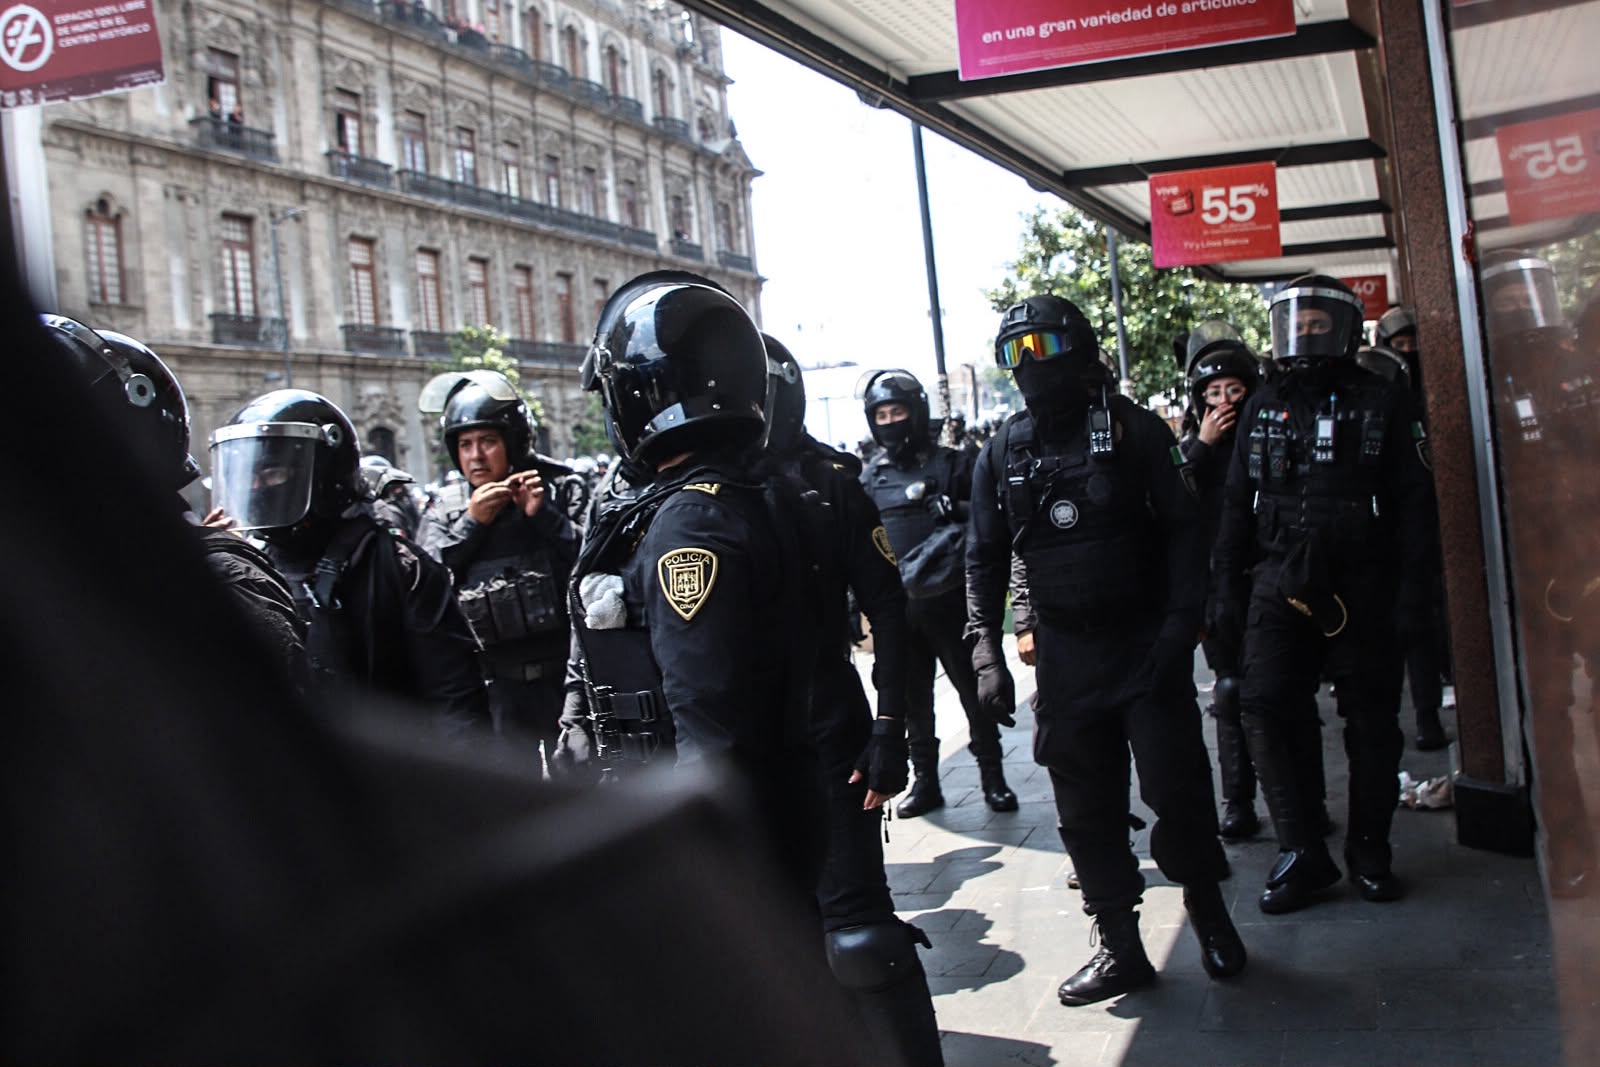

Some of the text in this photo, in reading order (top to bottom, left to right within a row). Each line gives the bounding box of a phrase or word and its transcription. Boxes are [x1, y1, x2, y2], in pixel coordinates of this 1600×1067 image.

[54, 9, 94, 25] ESPACIO
[56, 25, 71, 37] DE
[115, 15, 128, 26] EL
[982, 30, 1003, 43] en
[1006, 25, 1035, 40] una
[1039, 18, 1077, 38] gran
[1080, 4, 1152, 28] variedad
[1156, 3, 1177, 17] de
[58, 32, 98, 48] CENTRO
[1201, 183, 1270, 225] 55%
[664, 553, 710, 568] POLICIA
